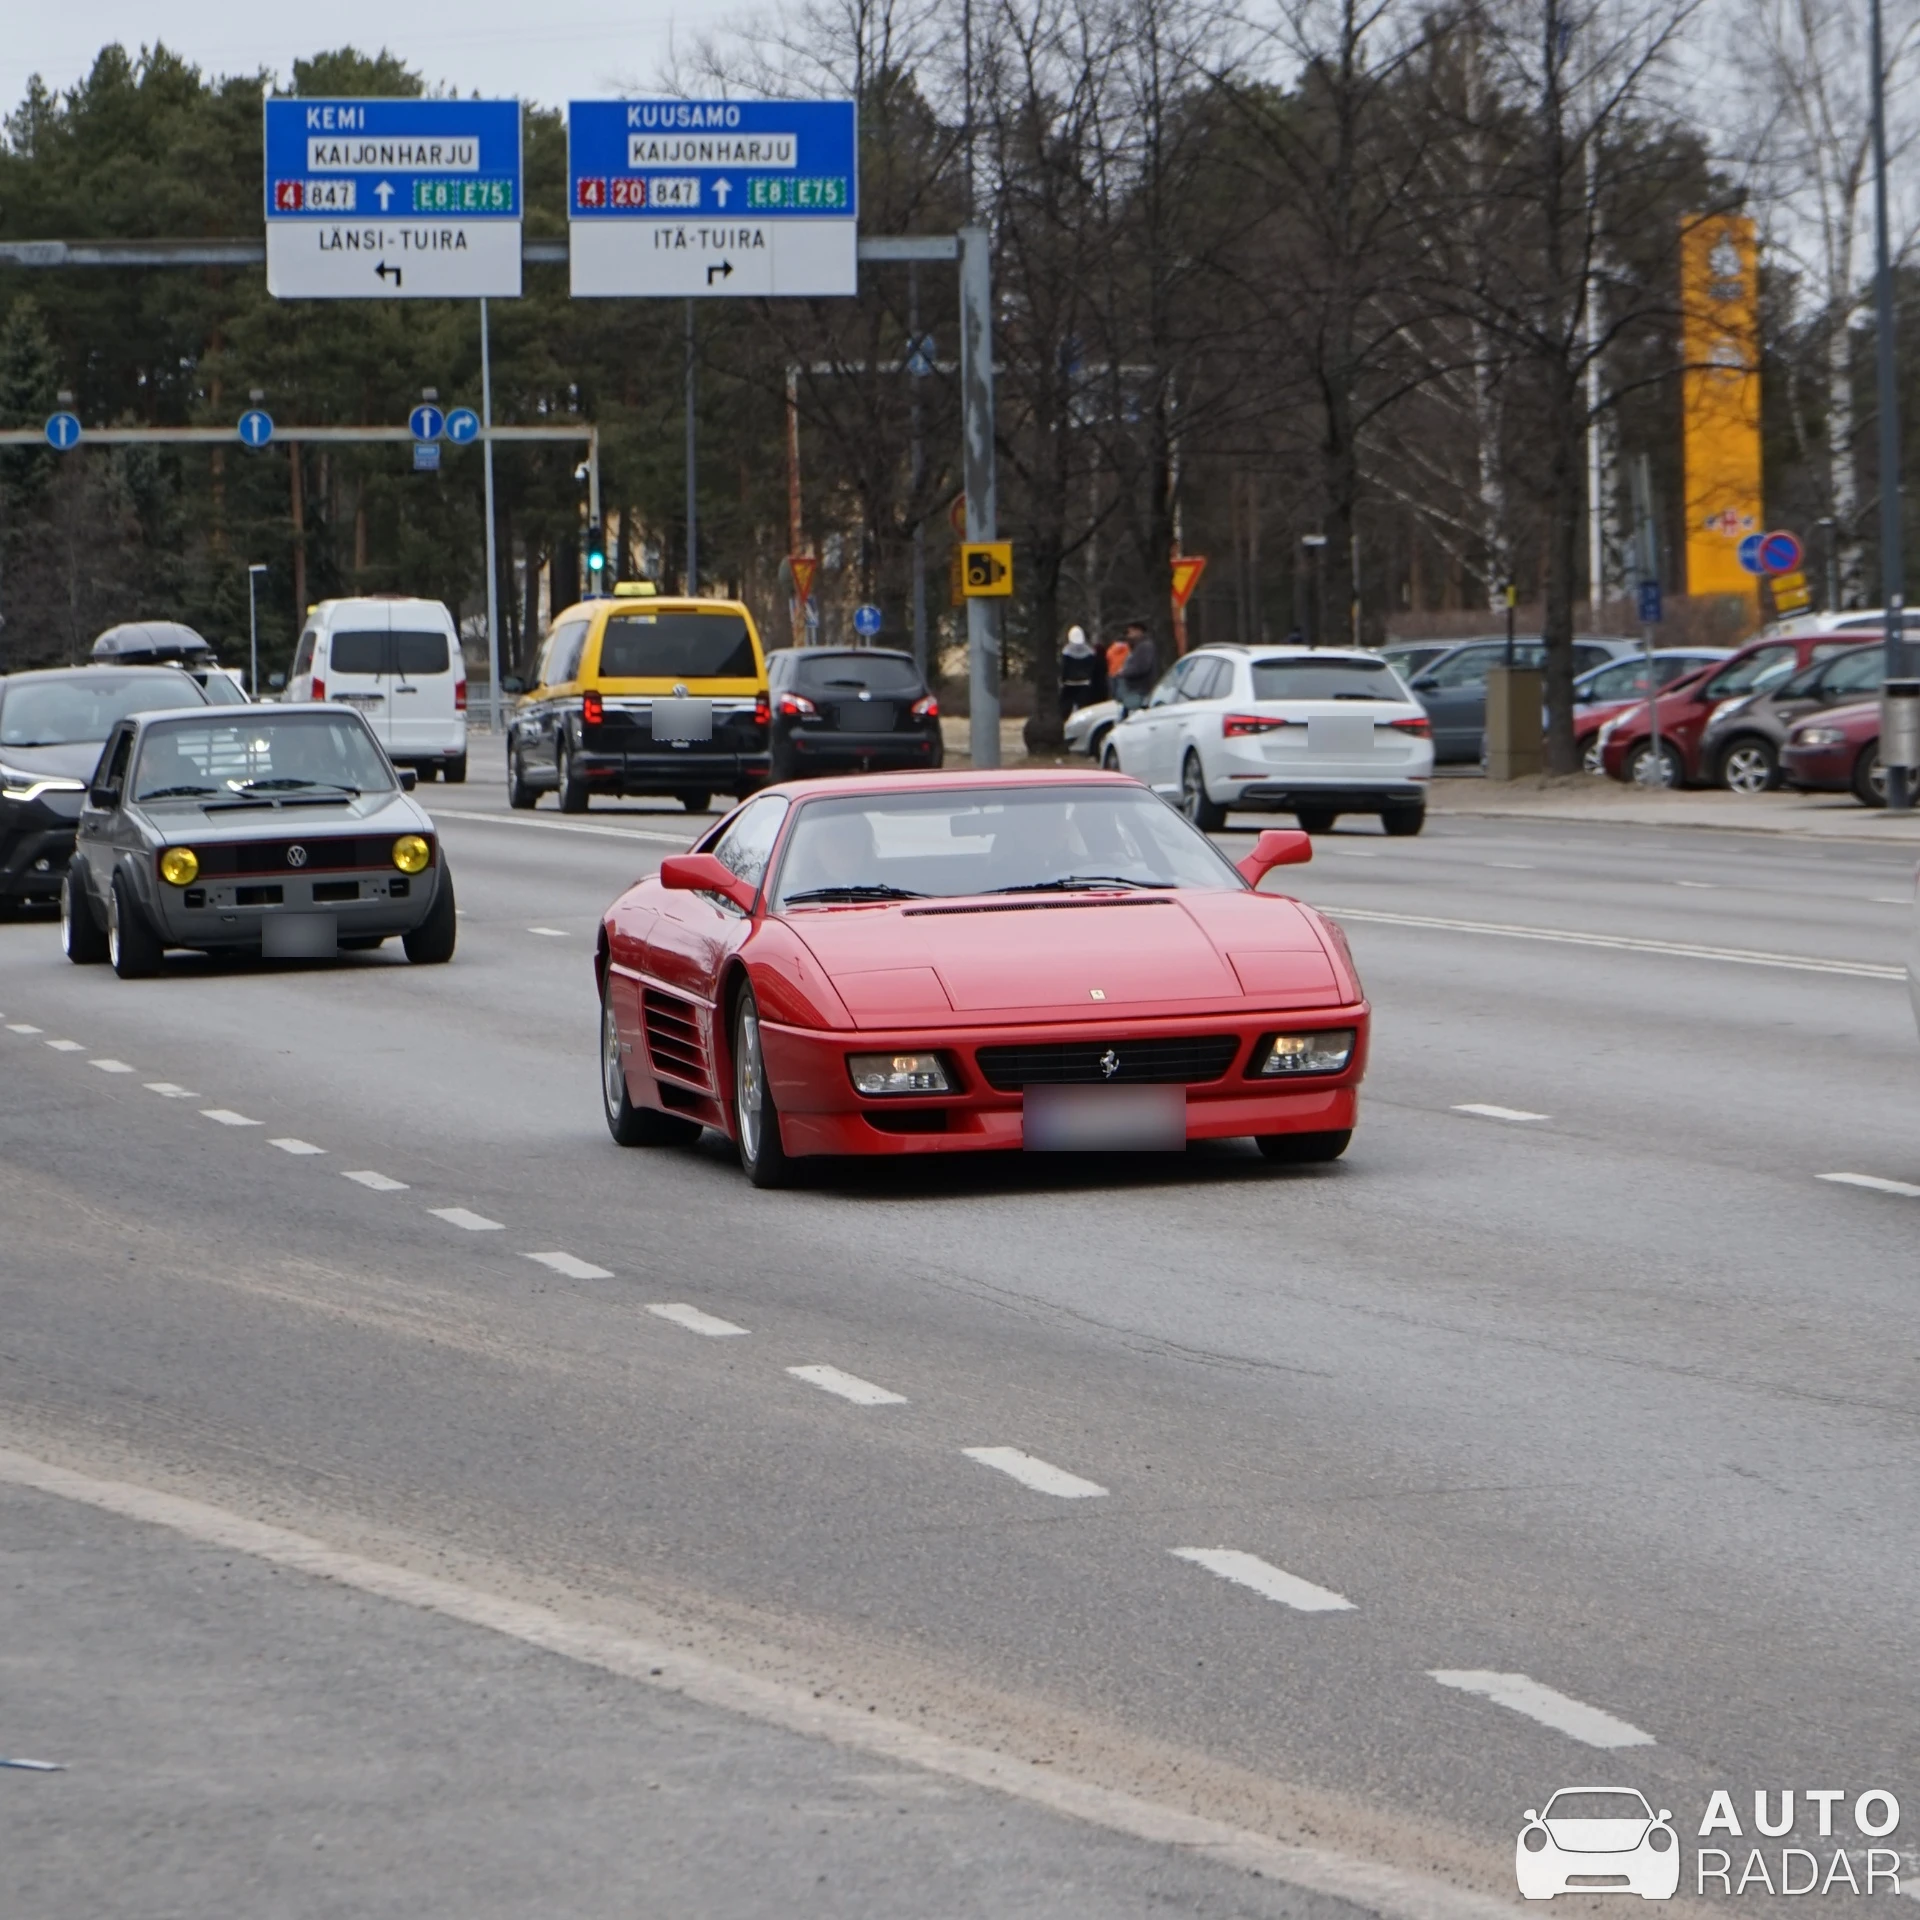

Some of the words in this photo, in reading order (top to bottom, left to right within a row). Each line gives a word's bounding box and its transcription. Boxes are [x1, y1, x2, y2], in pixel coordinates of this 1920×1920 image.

[307, 107, 365, 129] KEMI
[627, 105, 741, 127] KUUSAMO
[315, 145, 473, 165] KAIJONHARJU
[633, 141, 792, 161] KAIJONHARJU
[282, 186, 296, 206] 4
[311, 187, 350, 206] 847
[420, 186, 447, 206] E8
[464, 186, 504, 206] E75
[584, 184, 598, 204] 4
[615, 183, 643, 204] 20
[656, 184, 694, 203] 847
[754, 184, 780, 204] E8
[800, 184, 838, 204] E75
[319, 227, 468, 251] LÄNSI-TUIRA
[654, 225, 766, 249] ITÄ-TUIRA
